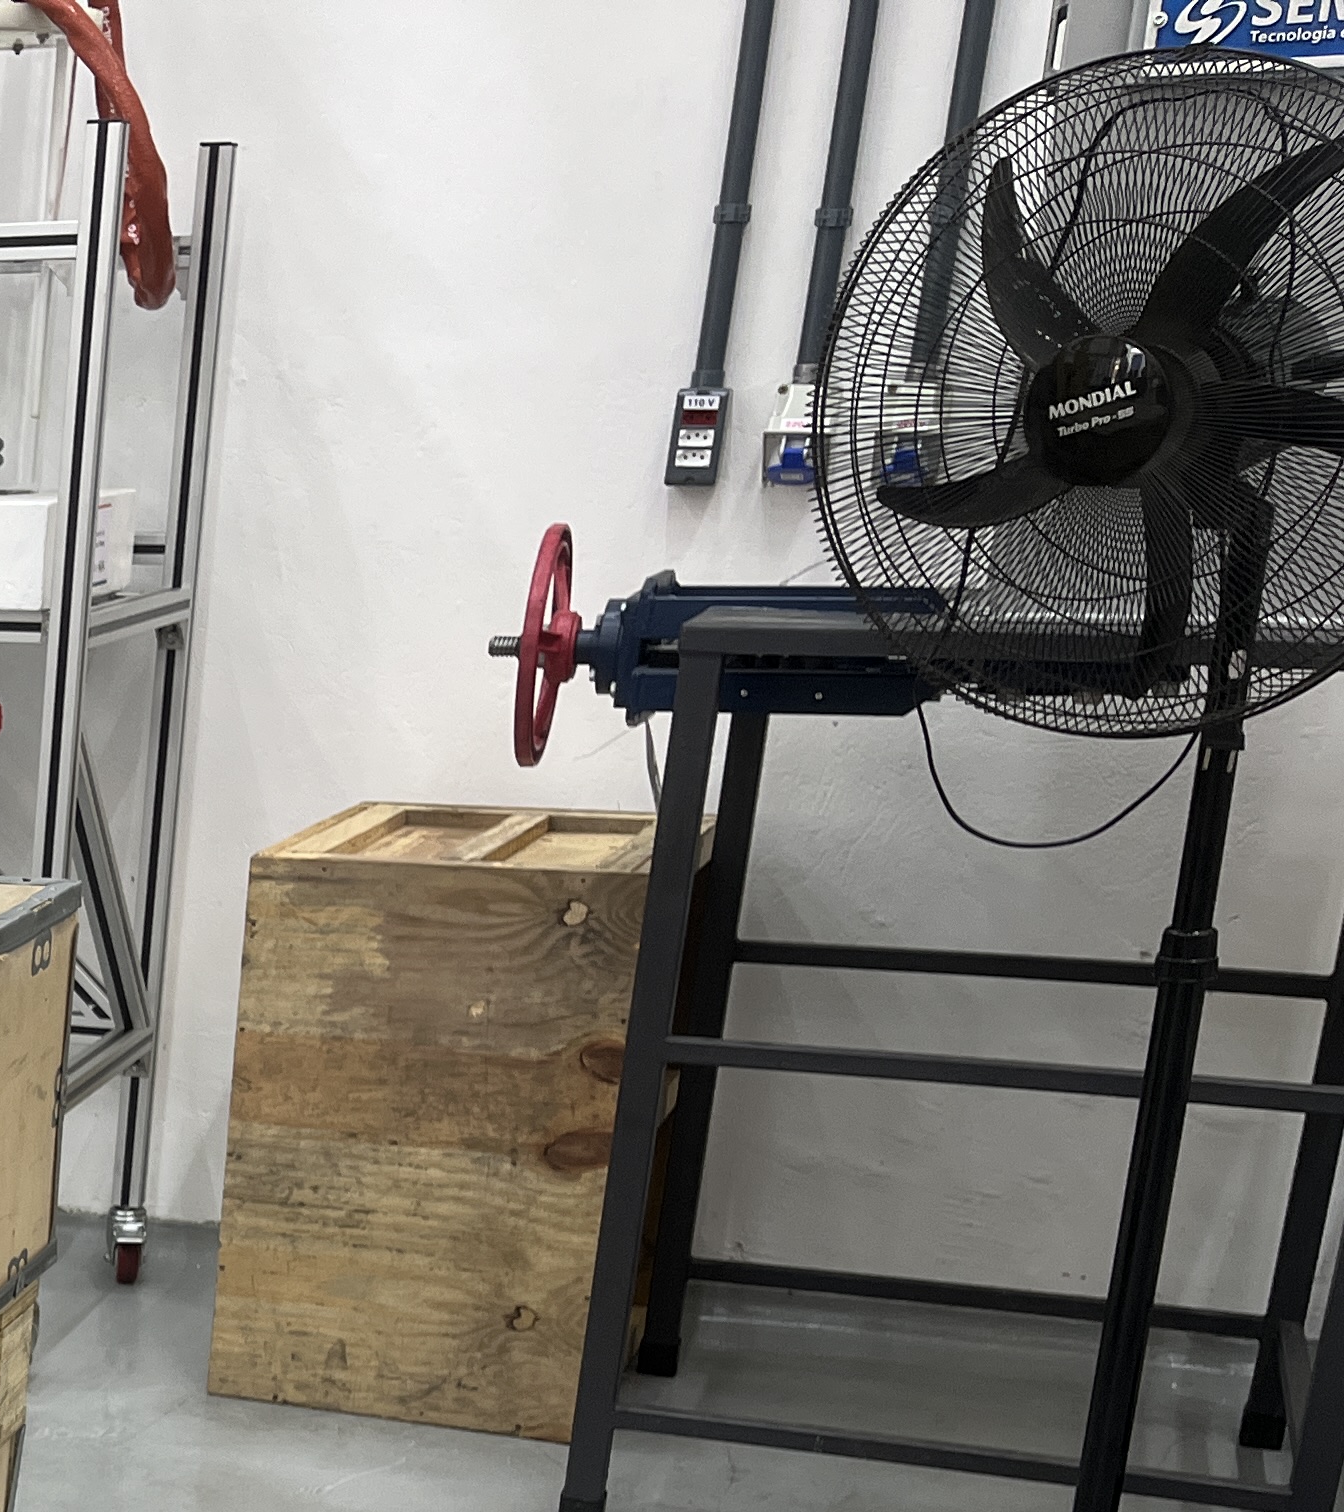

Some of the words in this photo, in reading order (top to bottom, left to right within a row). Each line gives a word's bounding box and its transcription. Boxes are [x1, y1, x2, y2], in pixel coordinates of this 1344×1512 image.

[1250, 26, 1335, 44] Tecnologia
[1049, 381, 1137, 420] MONDIAL
[1057, 422, 1089, 437] Turbo
